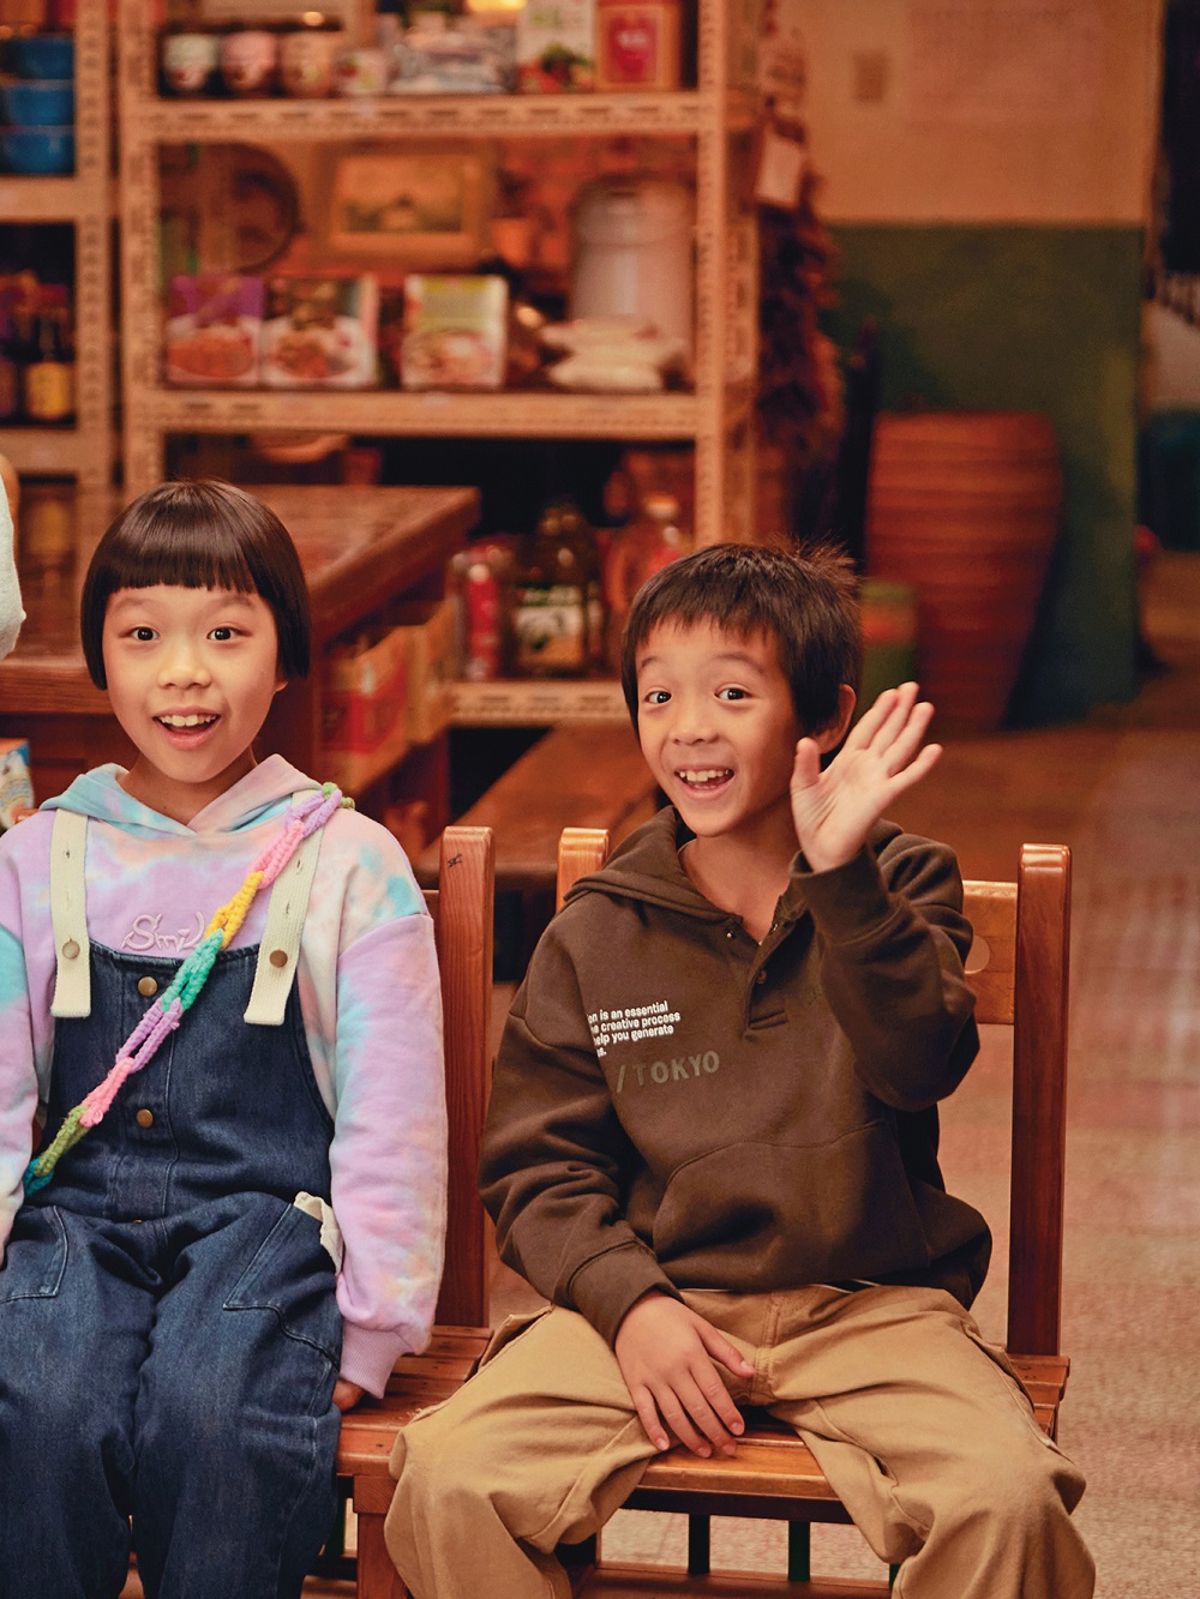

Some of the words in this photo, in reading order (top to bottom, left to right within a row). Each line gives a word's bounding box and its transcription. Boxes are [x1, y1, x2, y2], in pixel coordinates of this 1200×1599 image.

[600, 1009, 609, 1020] is
[611, 1010, 623, 1020] an
[625, 1000, 668, 1017] essential
[601, 1018, 640, 1032] creative
[641, 1012, 680, 1028] process
[612, 1031, 629, 1045] you
[631, 1024, 674, 1042] generate
